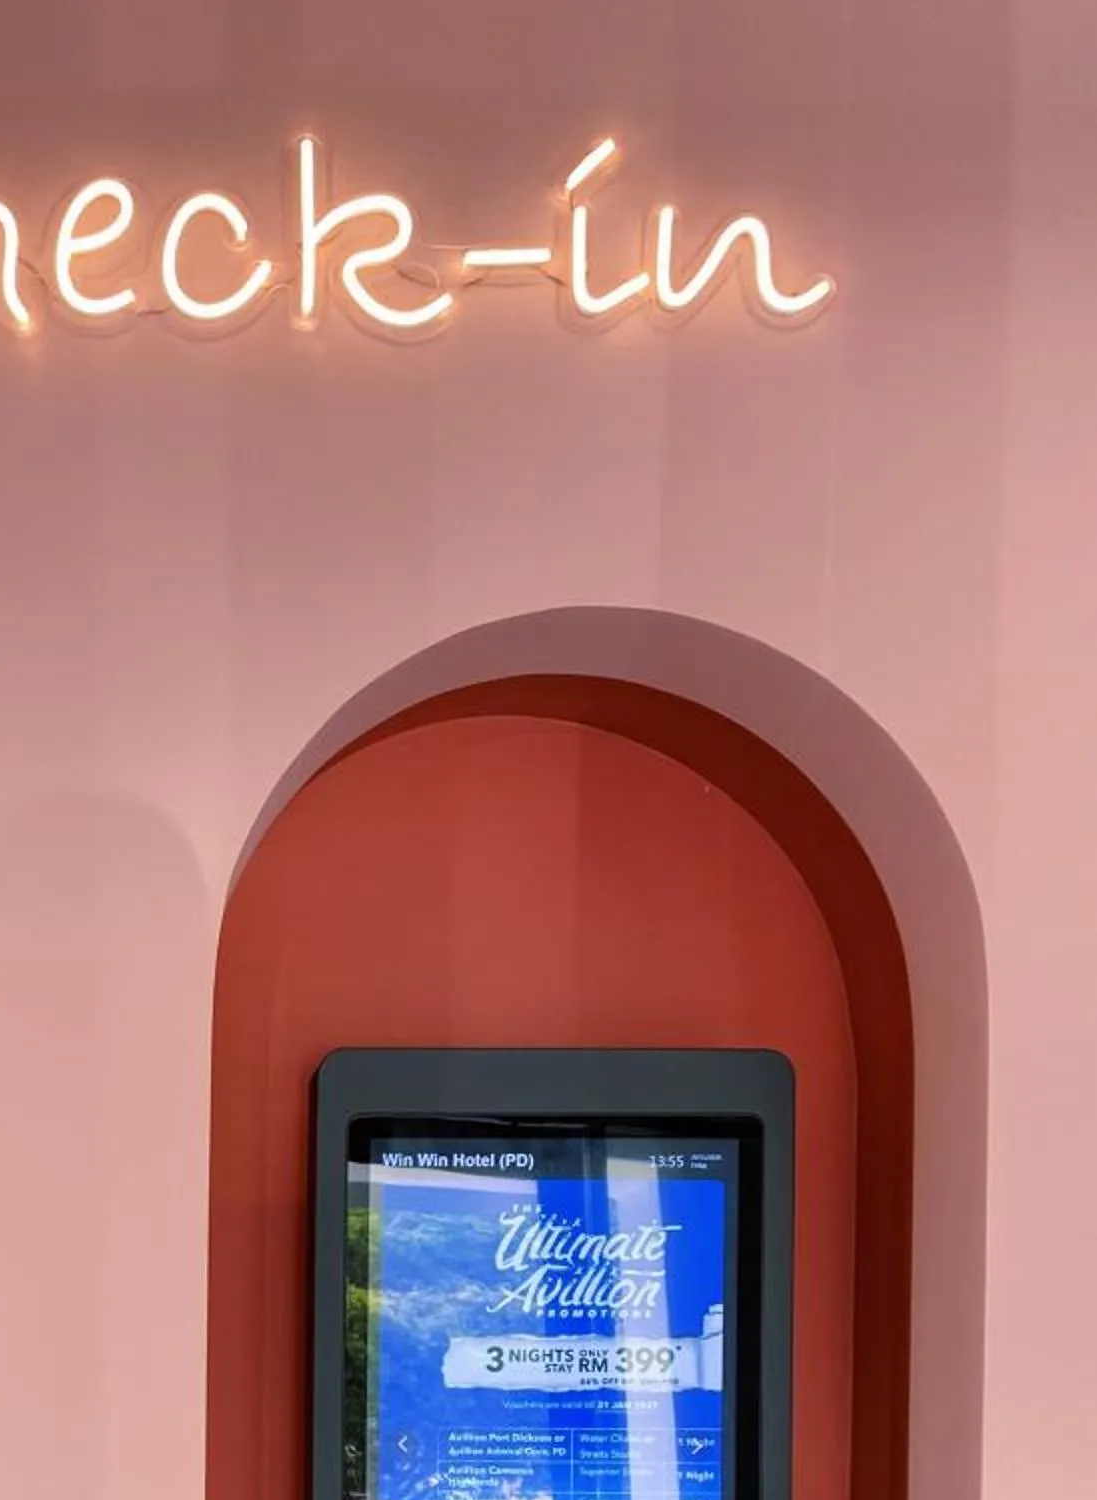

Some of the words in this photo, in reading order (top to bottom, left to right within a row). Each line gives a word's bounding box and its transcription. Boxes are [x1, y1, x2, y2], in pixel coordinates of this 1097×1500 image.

[382, 1152, 413, 1167] Win
[417, 1152, 448, 1167] Win
[452, 1152, 495, 1167] Hotel
[499, 1152, 534, 1170] (PD)
[494, 1211, 683, 1271] Ultimate
[486, 1263, 666, 1313] Avillion
[485, 1345, 503, 1373] 3
[508, 1348, 574, 1363] NIGHTS
[578, 1349, 610, 1358] ONLY
[544, 1363, 574, 1374] STAY
[578, 1357, 609, 1373] RM
